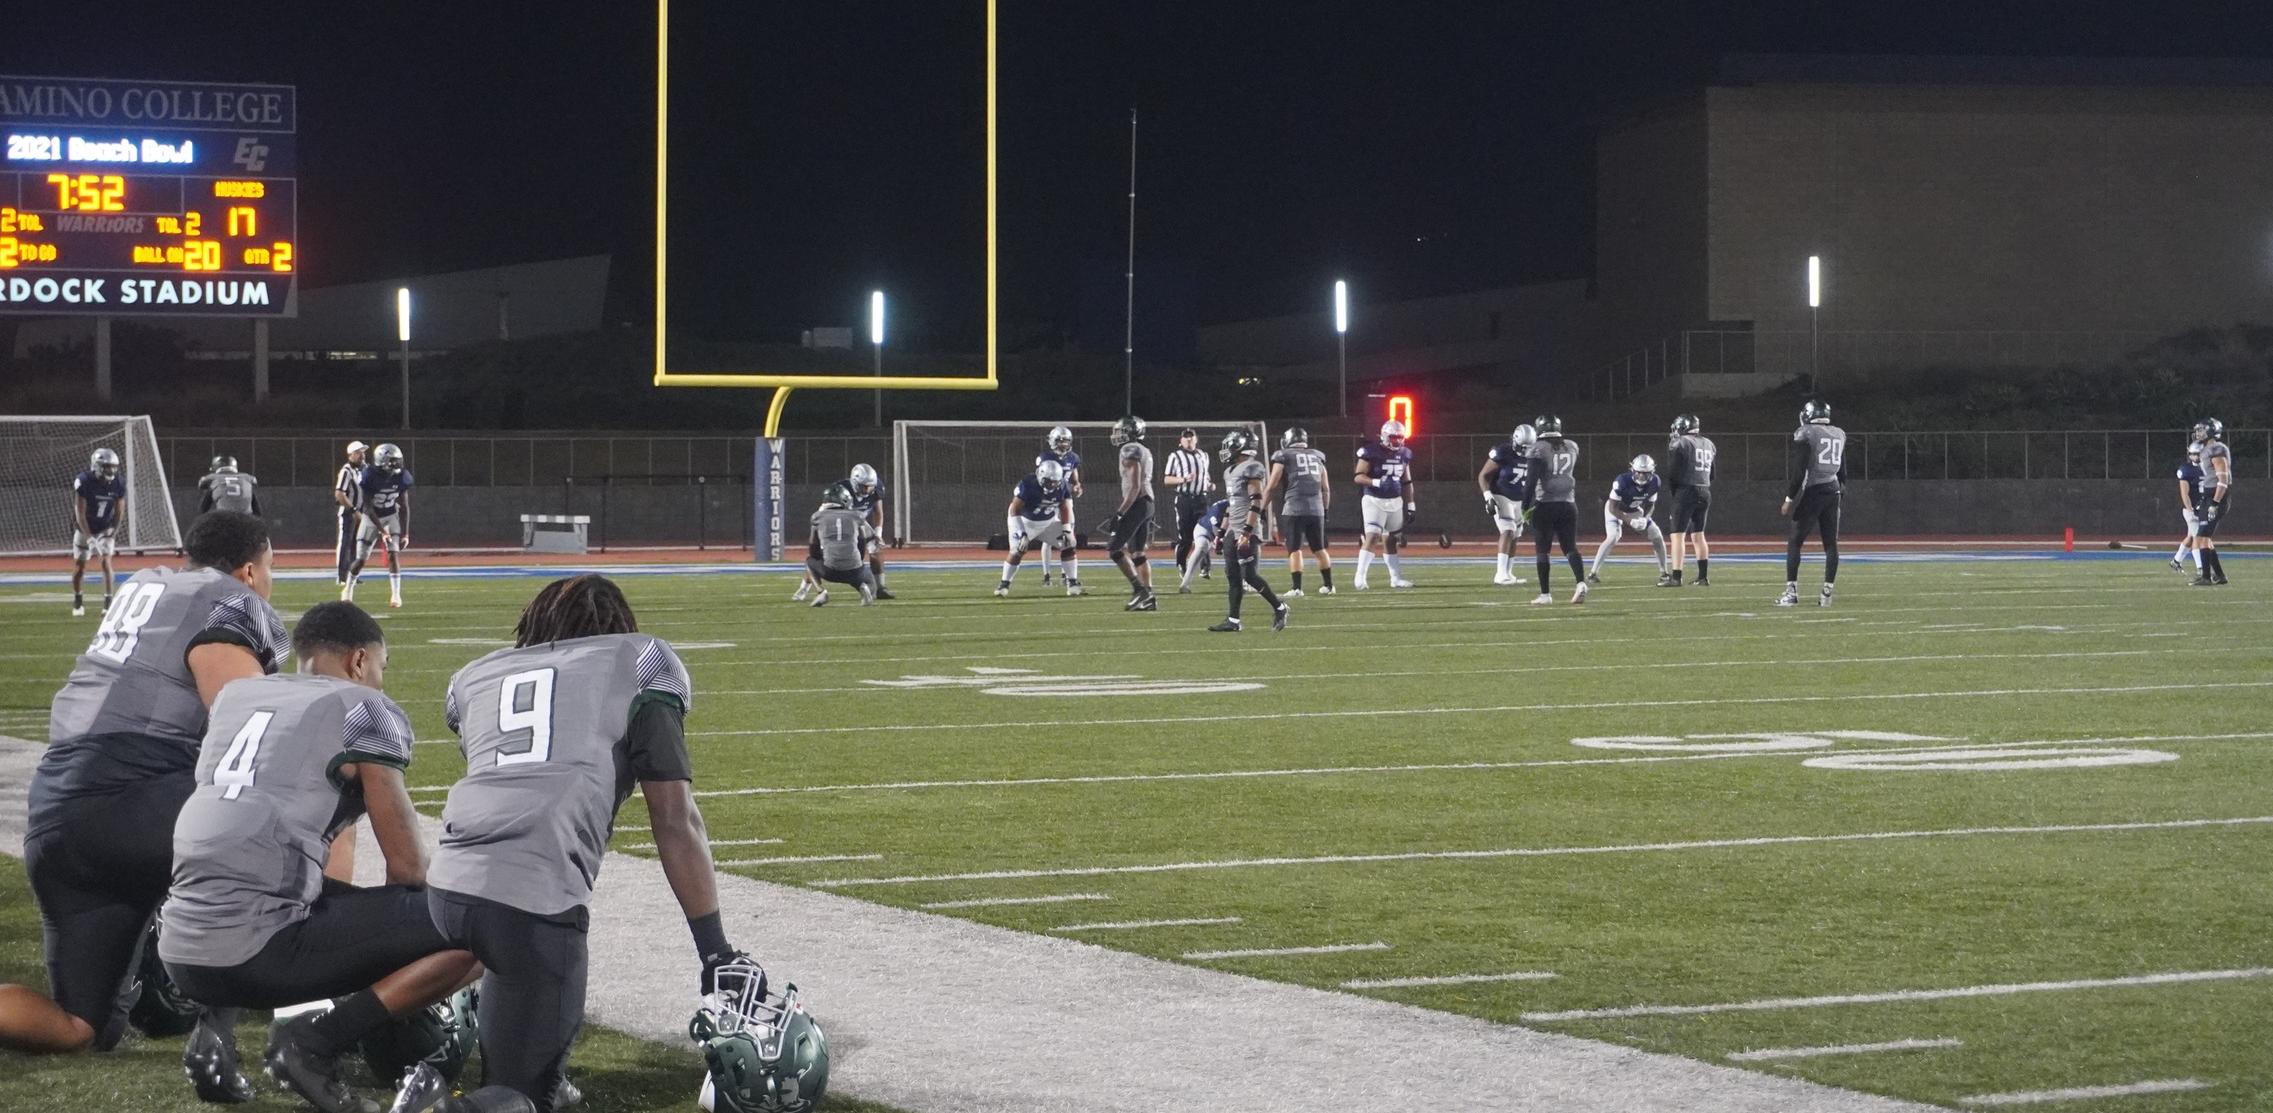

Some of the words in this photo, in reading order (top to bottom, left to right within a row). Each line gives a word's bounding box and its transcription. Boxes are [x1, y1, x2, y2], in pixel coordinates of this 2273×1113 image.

[122, 88, 282, 123] COLLEGE
[8, 134, 61, 160] 2021
[69, 136, 138, 162] Beach
[142, 138, 193, 163] Bowl
[48, 173, 124, 211] 7:52
[215, 181, 264, 198] HUSKIES
[1, 207, 16, 232] 2
[57, 215, 145, 233] WARRIORS
[186, 211, 200, 236] 2
[229, 206, 256, 236] 17
[20, 244, 38, 261] TO
[39, 244, 57, 261] GO
[134, 246, 165, 262] BALL
[166, 247, 184, 263] ON
[184, 241, 221, 270] 20
[273, 242, 292, 271] 2
[121, 279, 269, 305] STADIUM
[1296, 453, 1320, 475] 95
[1818, 438, 1842, 465] 20
[225, 477, 240, 496] 5
[96, 501, 113, 518] 1
[768, 439, 783, 561] WARRIORS
[836, 518, 842, 541] 1
[496, 667, 556, 767] 9
[213, 711, 273, 800] 4
